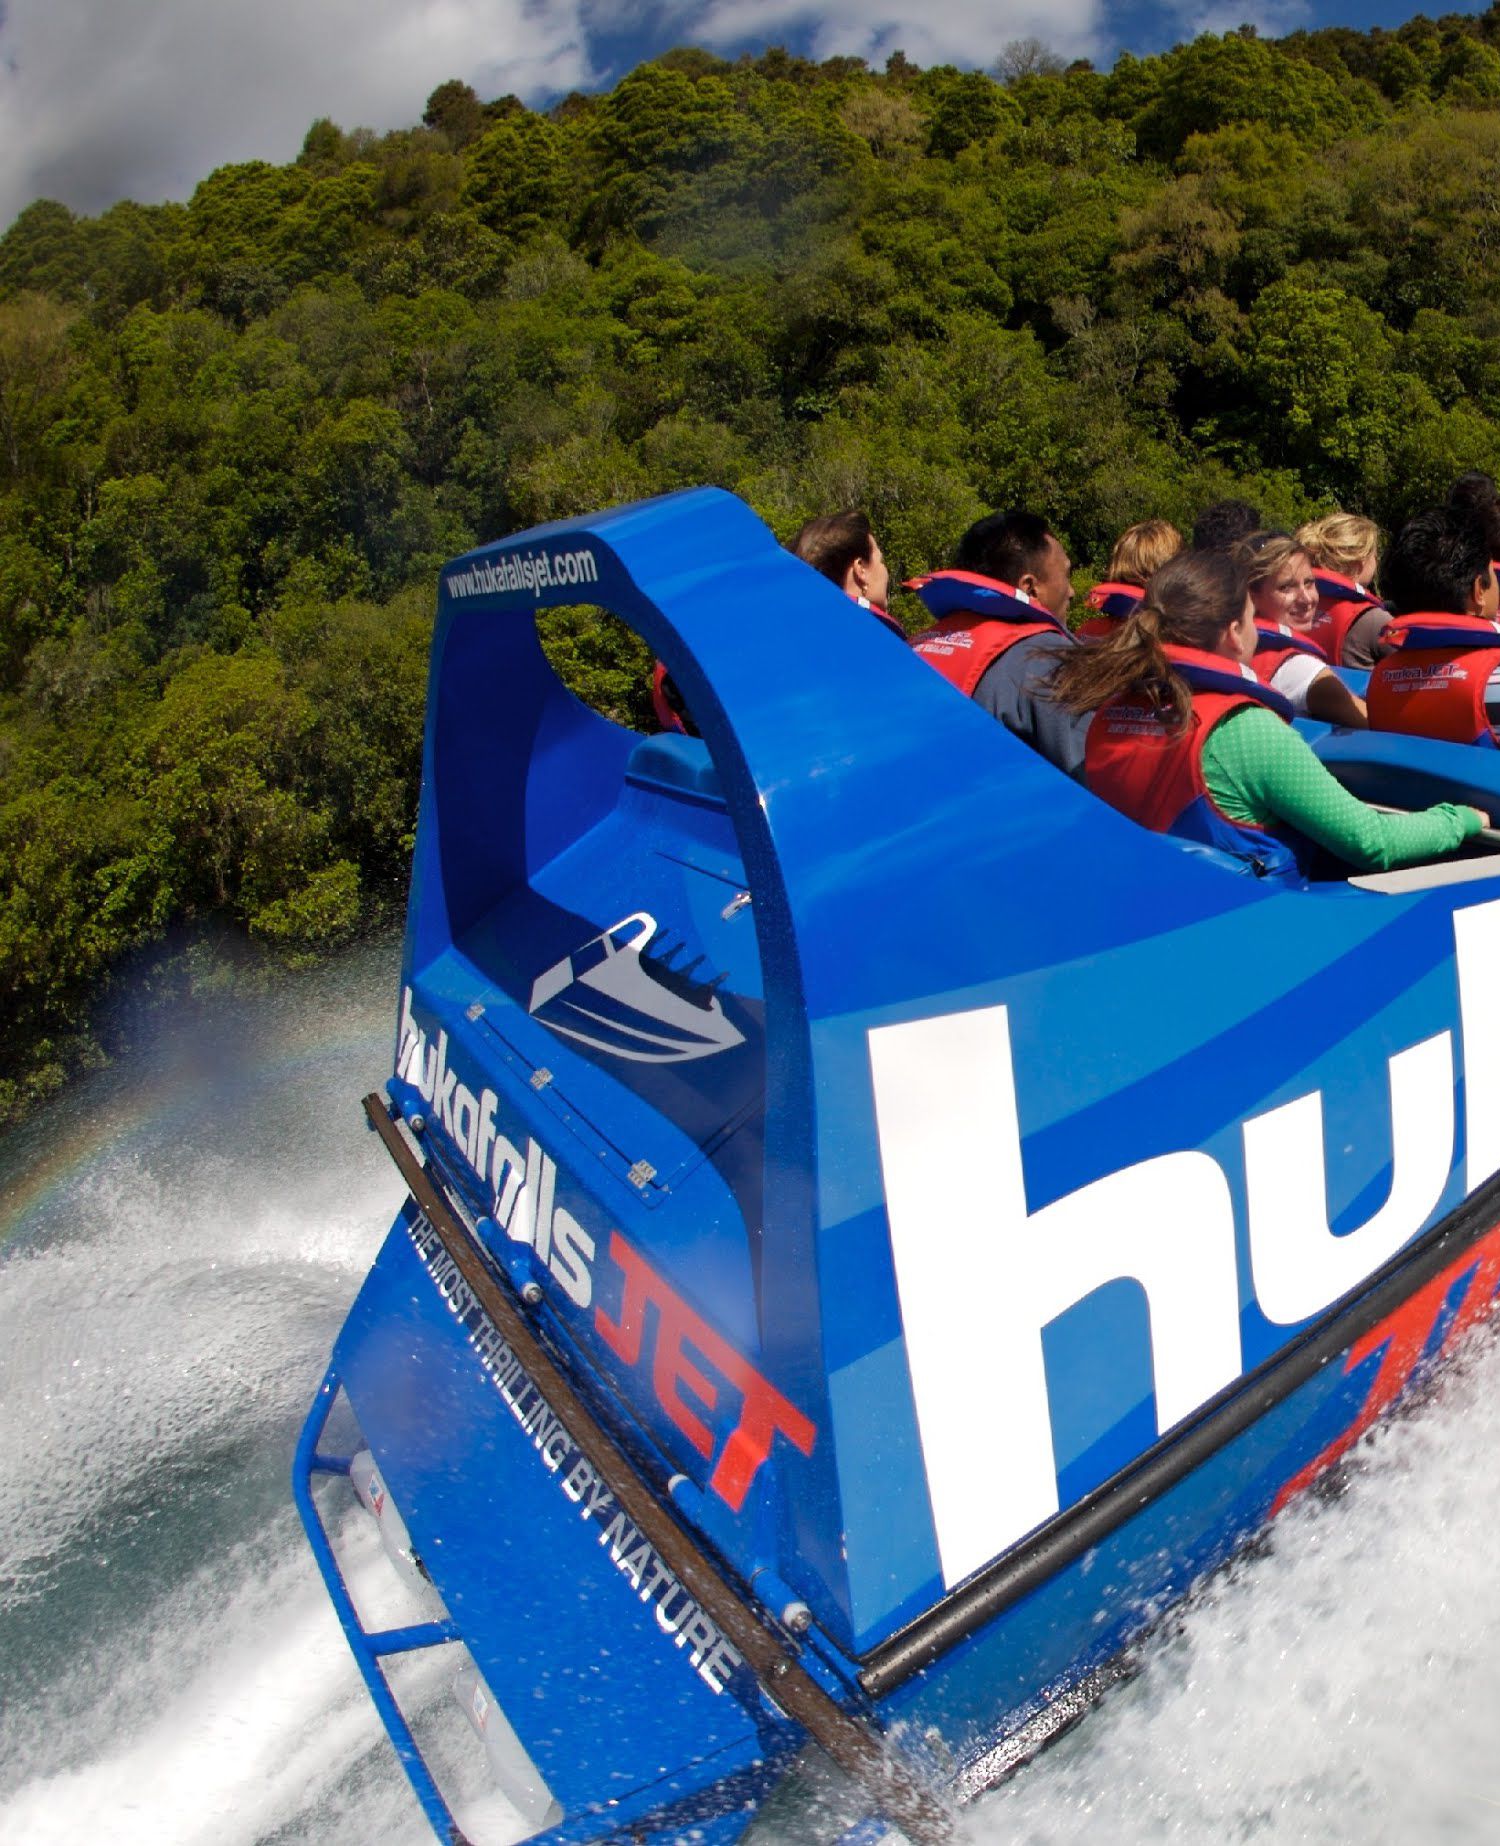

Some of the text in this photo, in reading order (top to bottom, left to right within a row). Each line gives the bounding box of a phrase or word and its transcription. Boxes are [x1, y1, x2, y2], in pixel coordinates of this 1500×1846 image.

[447, 549, 598, 598] www.hukafallsjet.com
[396, 985, 817, 1513] hukafalls JET
[407, 1209, 742, 1693] THE MOST THRILLING BY NATURE
